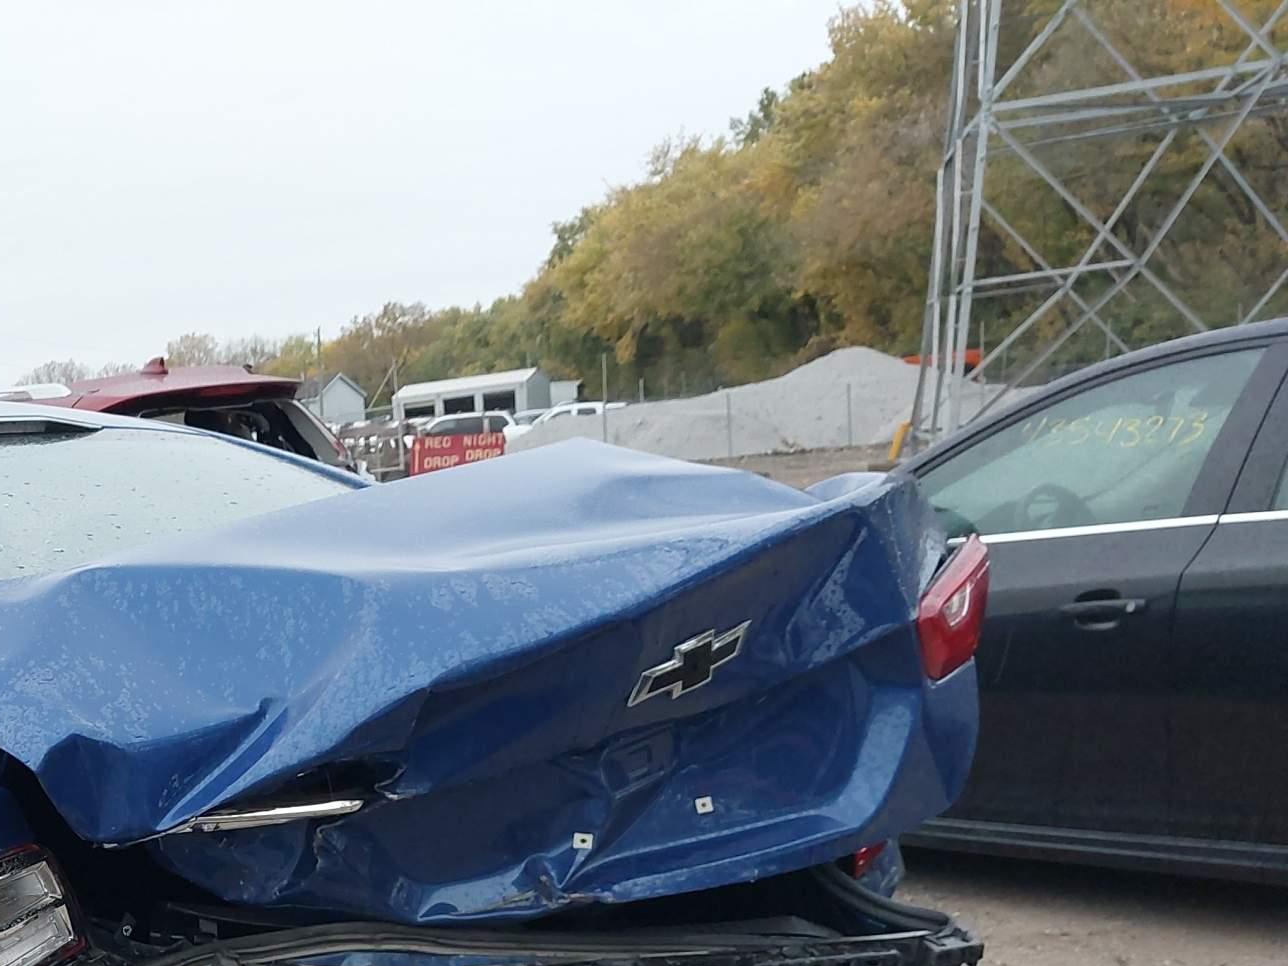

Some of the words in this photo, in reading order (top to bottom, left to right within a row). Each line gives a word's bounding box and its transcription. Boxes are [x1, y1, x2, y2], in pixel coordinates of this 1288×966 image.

[462, 432, 504, 447] NIGHT
[465, 447, 502, 461] DROP
[423, 454, 460, 470] DROP
